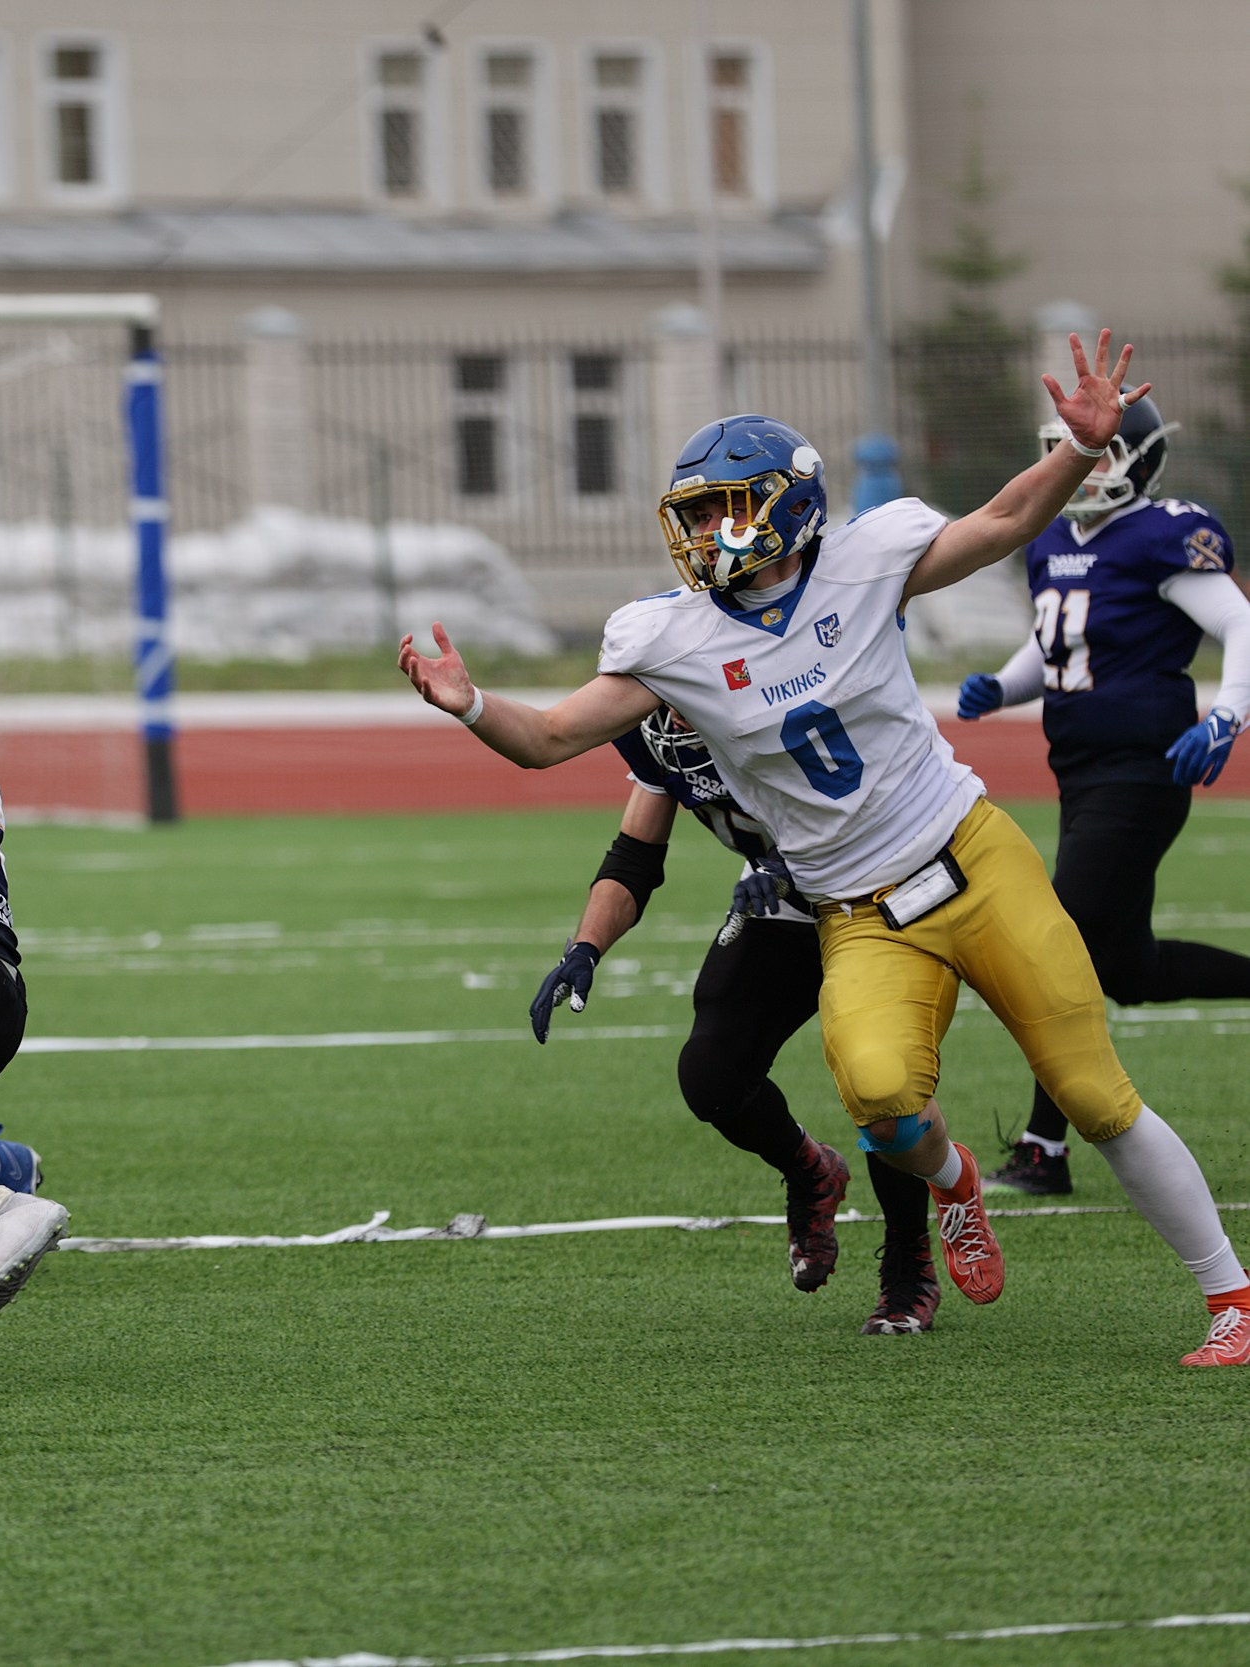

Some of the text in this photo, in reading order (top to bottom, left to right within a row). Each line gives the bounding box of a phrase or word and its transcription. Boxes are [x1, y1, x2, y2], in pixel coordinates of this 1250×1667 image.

[760, 662, 827, 707] VIKINGS
[1034, 587, 1094, 693] 21
[780, 700, 864, 800] 0
